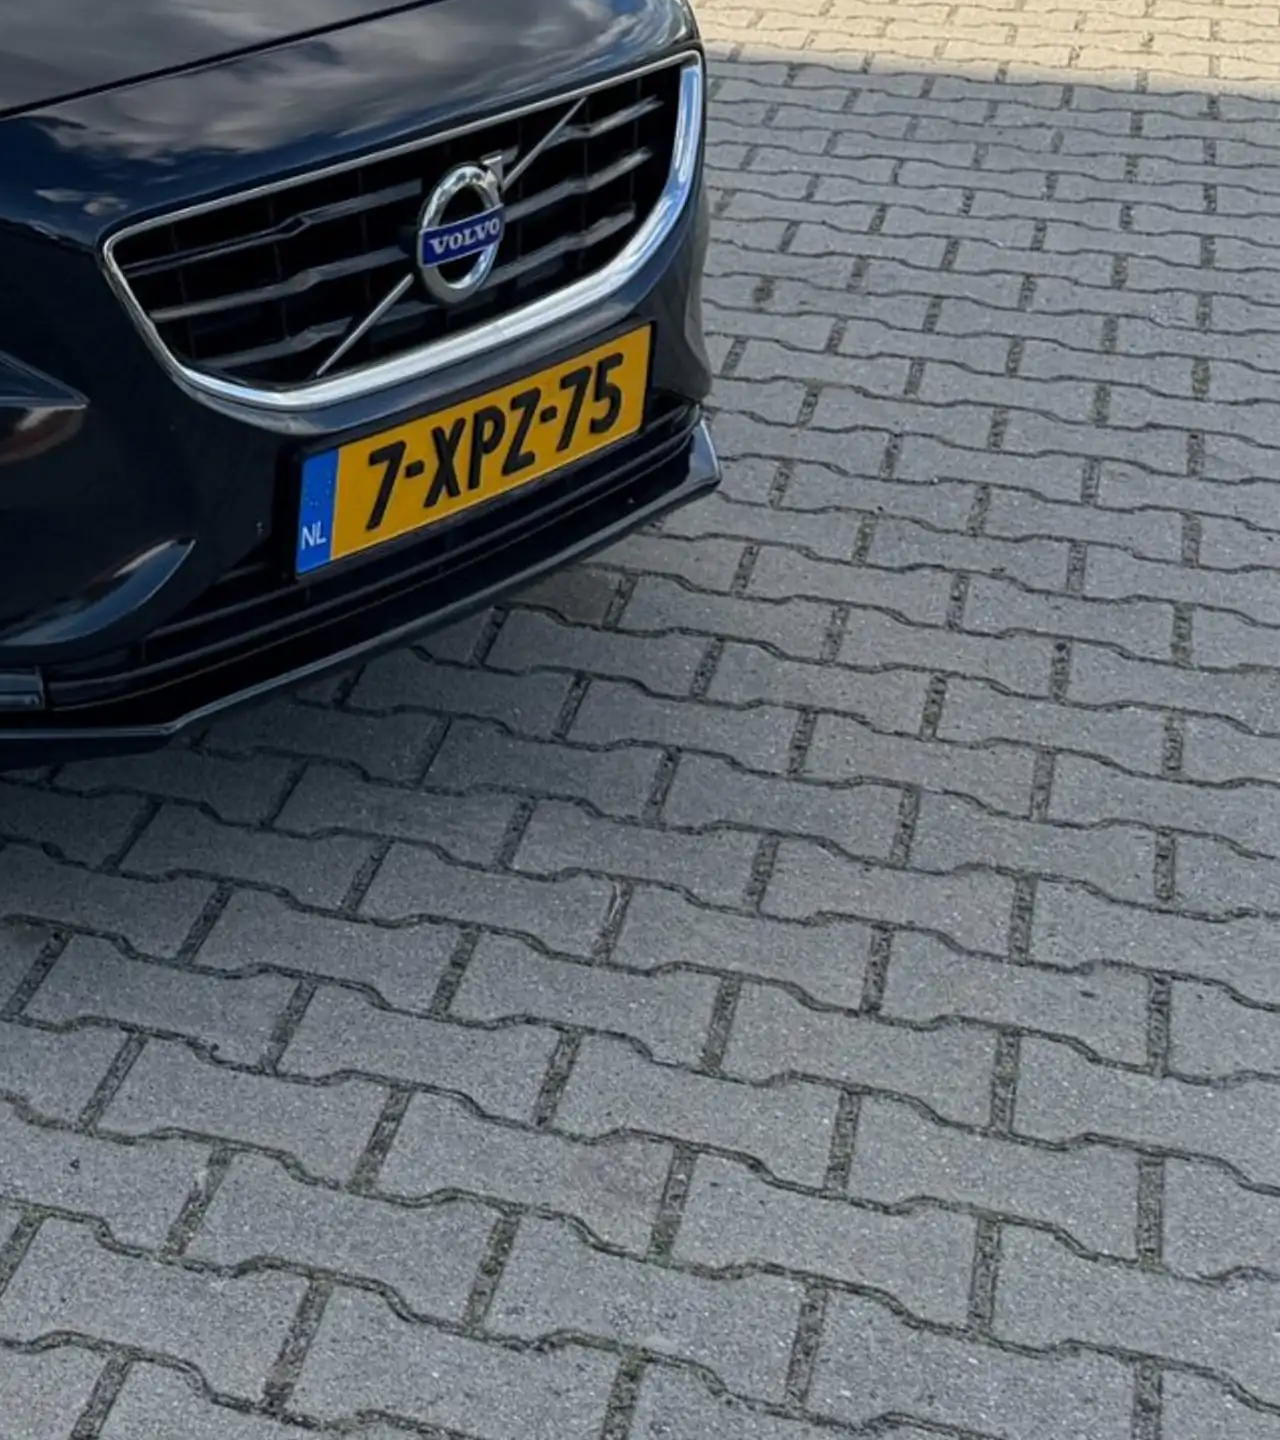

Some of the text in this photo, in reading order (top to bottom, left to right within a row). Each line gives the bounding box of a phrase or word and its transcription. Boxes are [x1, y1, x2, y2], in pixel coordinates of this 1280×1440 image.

[428, 217, 500, 255] VOLVO
[366, 352, 624, 532] 7-XPZ-75
[301, 520, 328, 551] NL
